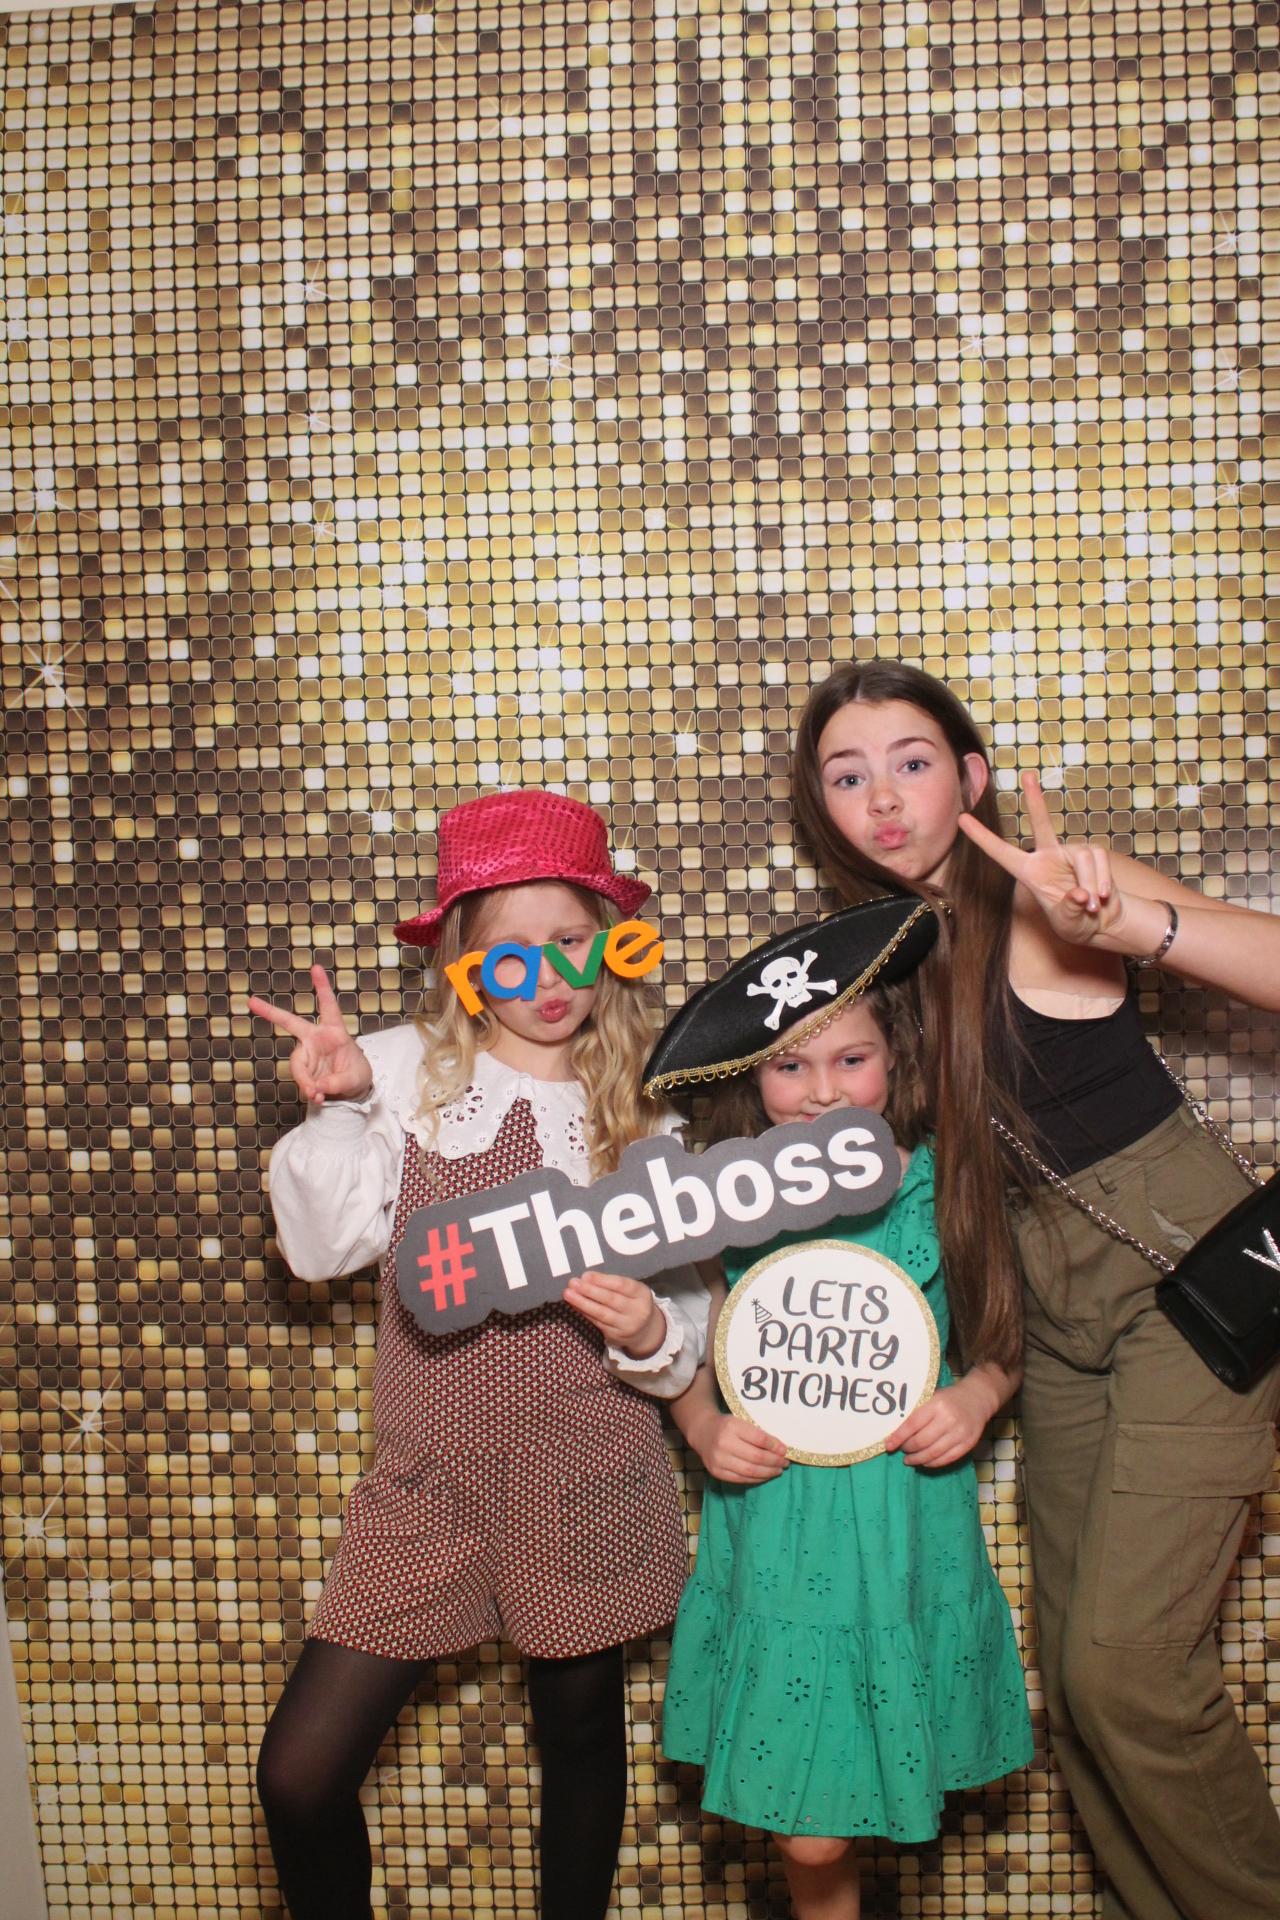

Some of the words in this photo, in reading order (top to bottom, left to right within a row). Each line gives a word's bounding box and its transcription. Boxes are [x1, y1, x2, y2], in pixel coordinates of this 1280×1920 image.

[443, 919, 665, 1018] rave
[416, 1126, 885, 1313] #Theboss
[781, 1276, 889, 1325] LETS
[758, 1319, 900, 1371] PARTY
[740, 1365, 909, 1418] BITCHES!
